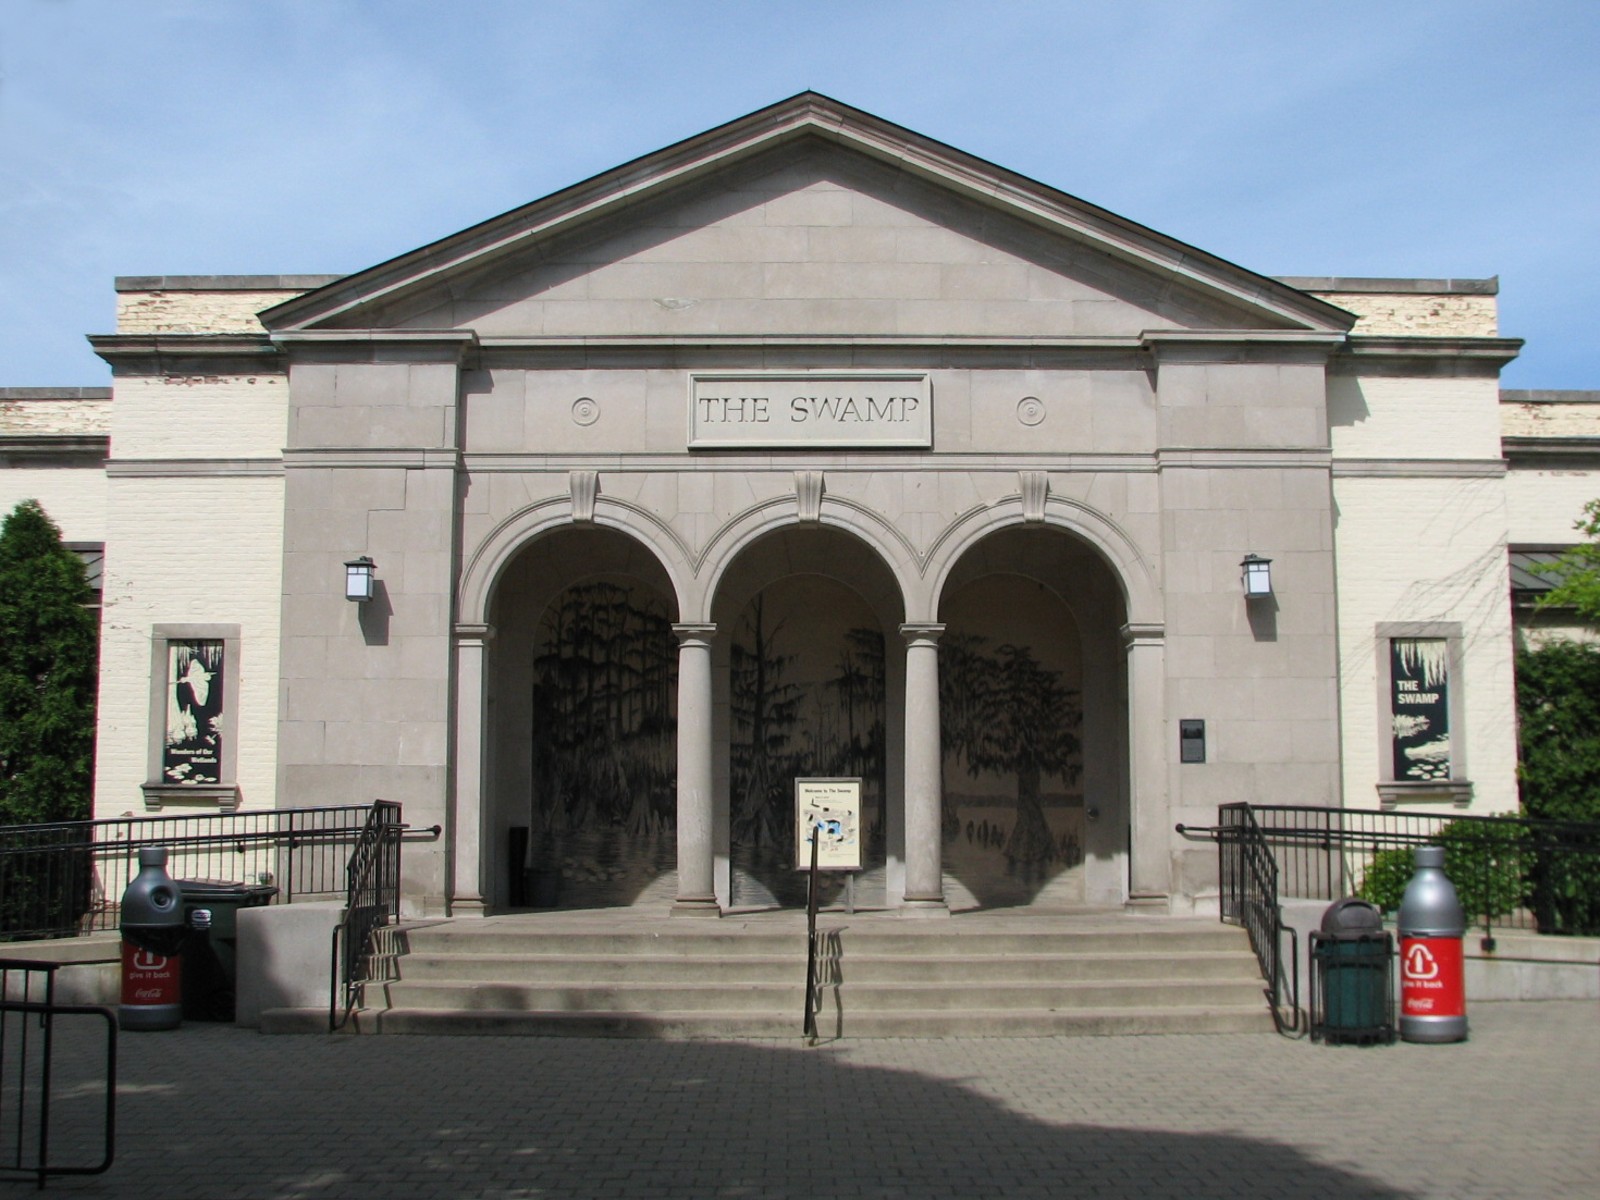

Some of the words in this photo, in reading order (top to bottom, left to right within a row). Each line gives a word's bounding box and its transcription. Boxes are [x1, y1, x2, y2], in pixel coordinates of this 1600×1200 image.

[699, 397, 770, 423] THE
[790, 397, 920, 423] SWAMP
[1397, 680, 1419, 691] THE
[1398, 693, 1439, 704] SWAMP
[129, 971, 143, 980] give
[153, 970, 171, 978] back
[1416, 980, 1422, 988] it
[1423, 980, 1444, 988] back
